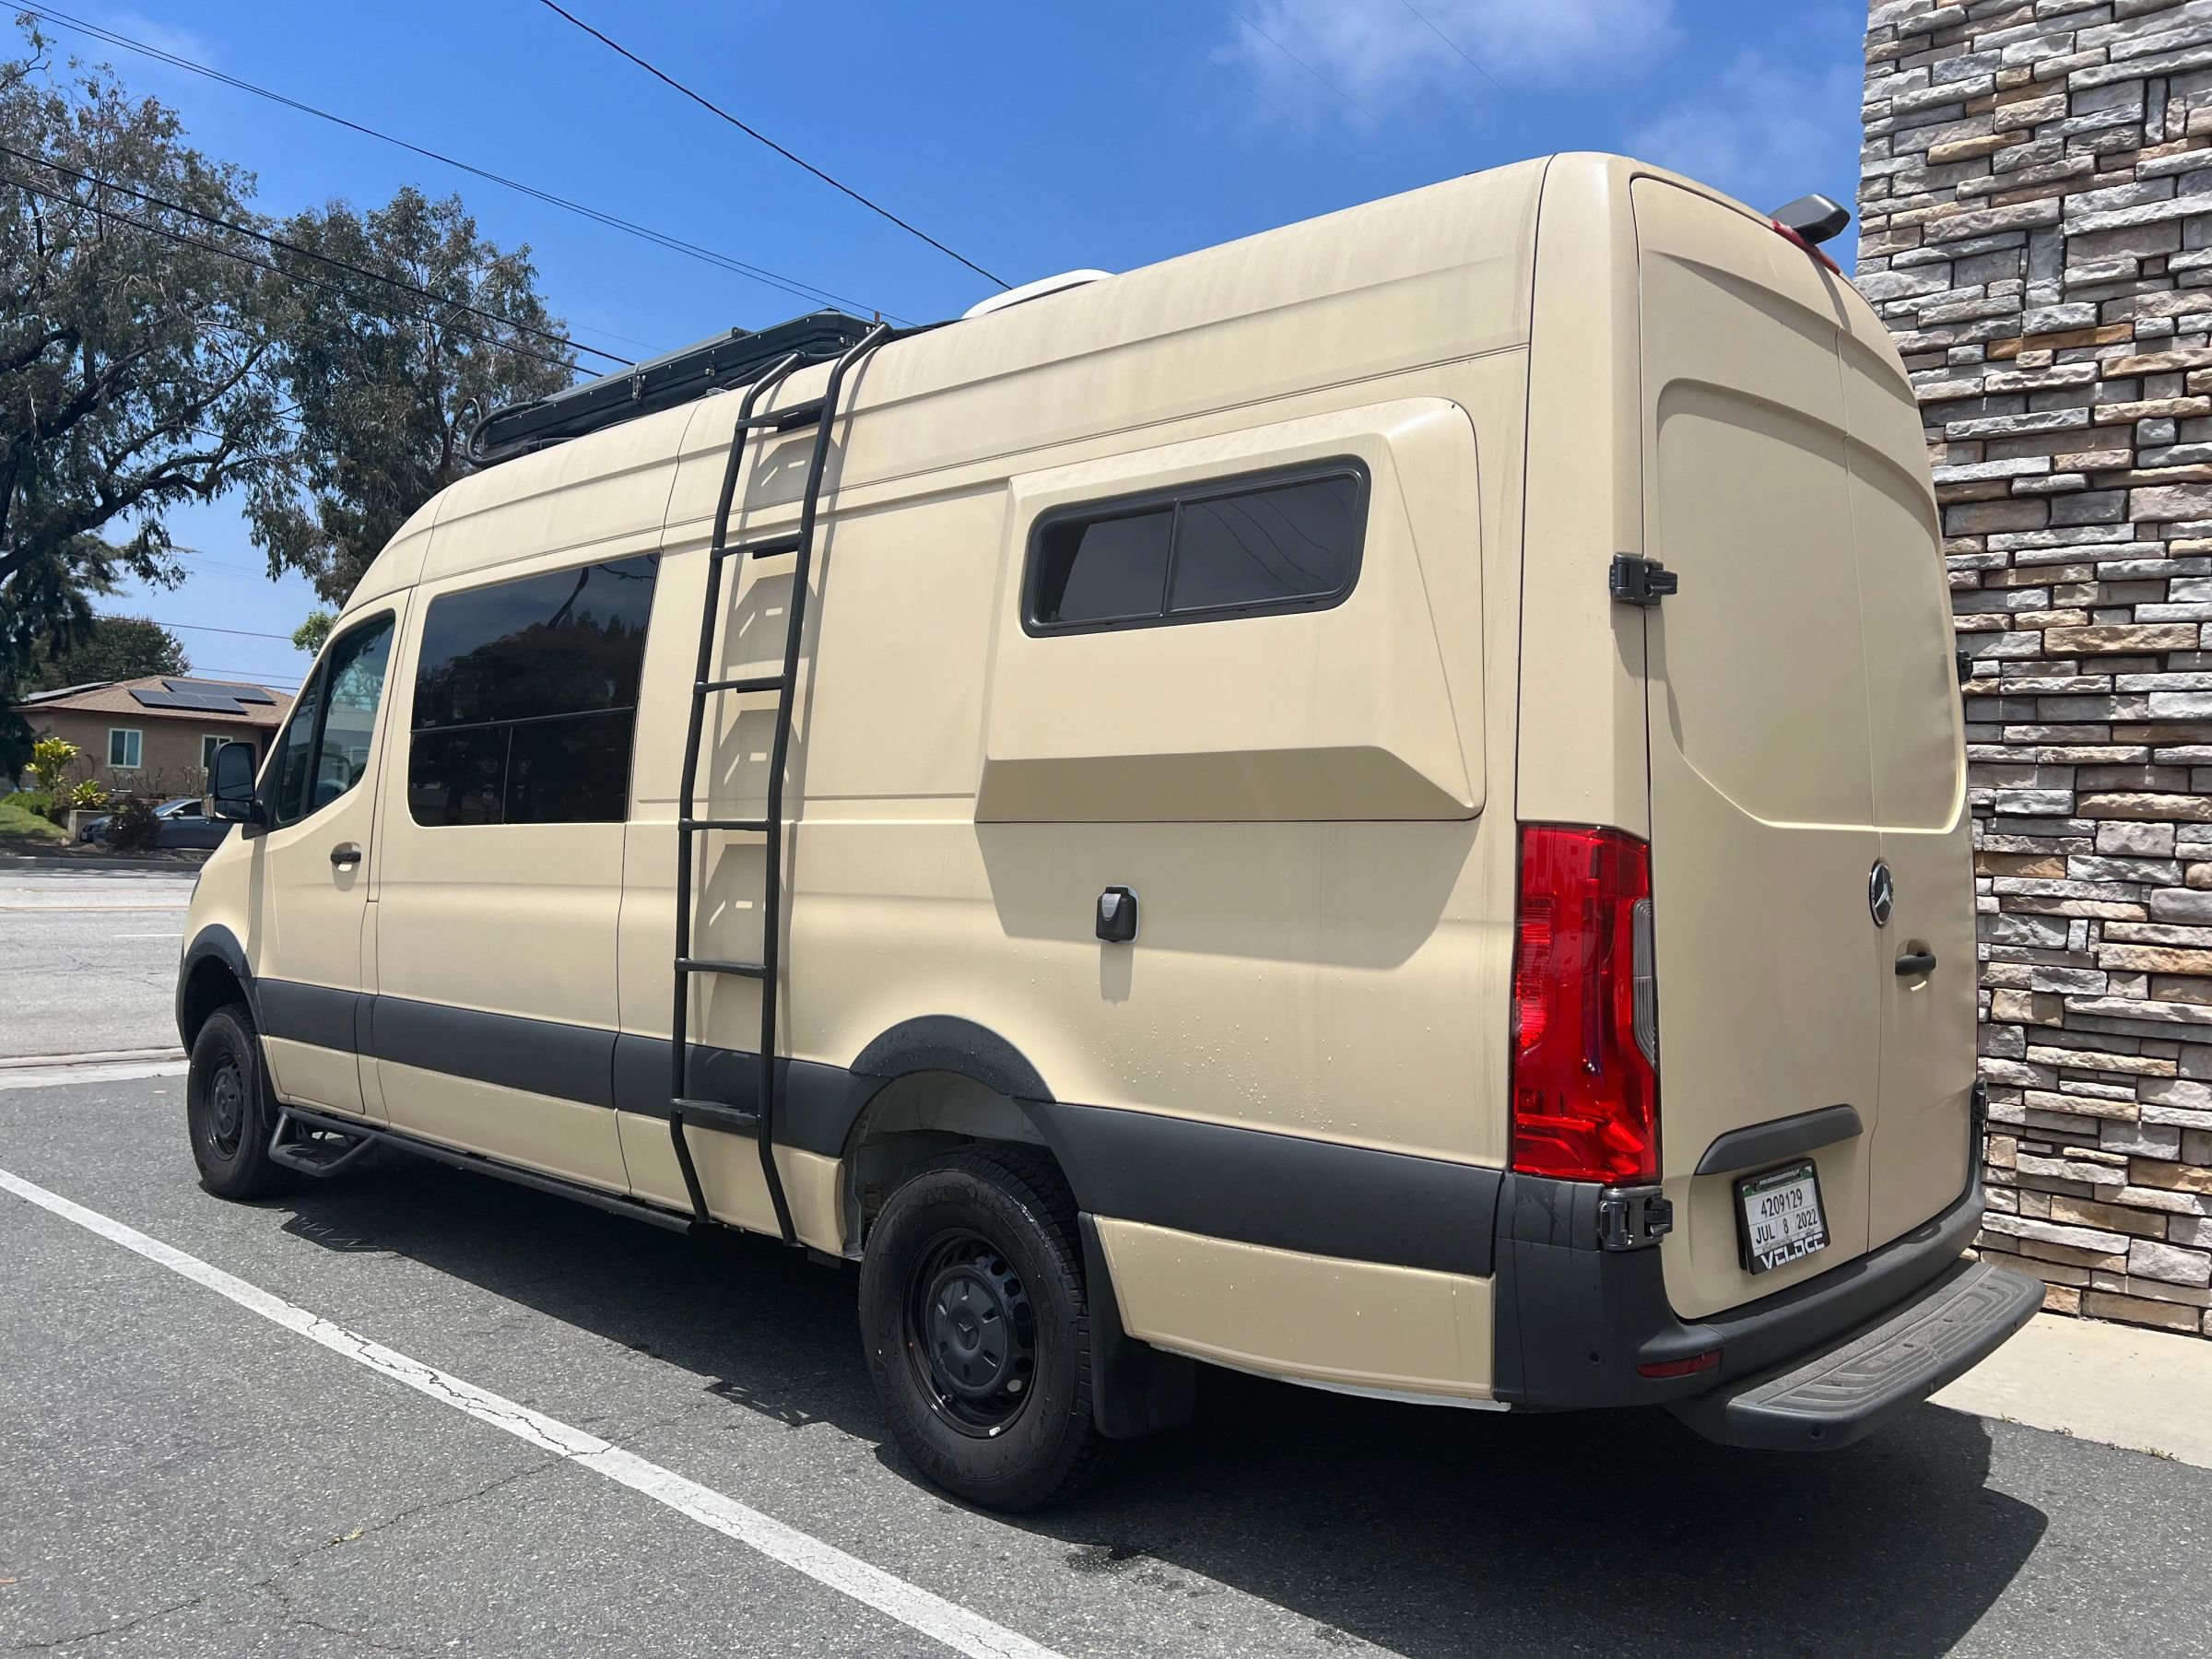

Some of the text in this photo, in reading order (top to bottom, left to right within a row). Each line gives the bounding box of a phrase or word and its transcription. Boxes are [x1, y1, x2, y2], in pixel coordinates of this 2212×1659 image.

[1761, 1188, 1803, 1218] 4209129
[1756, 1224, 1776, 1244] JUL
[1783, 1218, 1790, 1234] 8
[1796, 1208, 1818, 1230] 2022
[1760, 1232, 1825, 1269] VELOCE
